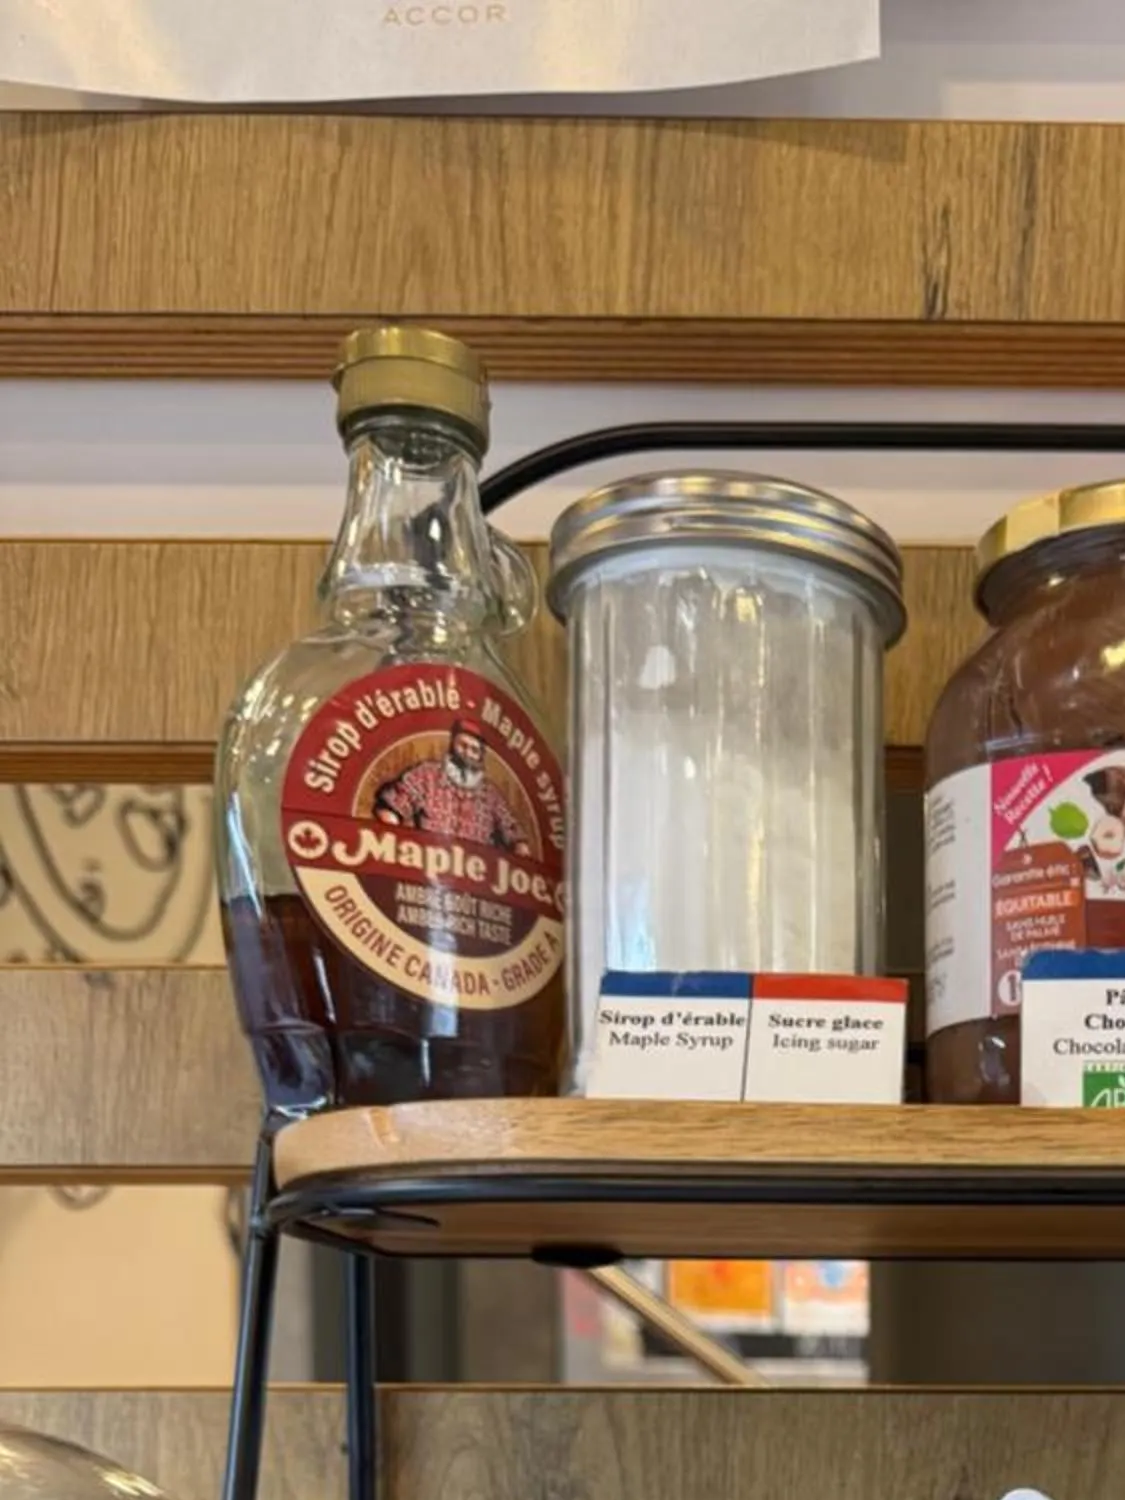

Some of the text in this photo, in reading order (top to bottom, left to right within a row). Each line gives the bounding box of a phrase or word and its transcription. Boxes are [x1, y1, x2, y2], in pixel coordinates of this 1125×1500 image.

[382, 5, 508, 27] ACCOR
[303, 719, 362, 794] Sirop
[355, 677, 461, 730] d'érable
[481, 697, 541, 770] Maple
[536, 771, 566, 850] syrup
[331, 828, 487, 883] Maple
[323, 884, 405, 968] ORIGINE
[403, 953, 491, 996] CANADA
[500, 947, 548, 992] GRADE
[543, 929, 560, 953] A
[600, 1009, 746, 1030] Sirop d'érable
[768, 1013, 884, 1031] Sucre glace
[608, 1031, 735, 1051] Maple Syrup
[772, 1033, 881, 1054] Icing sugar
